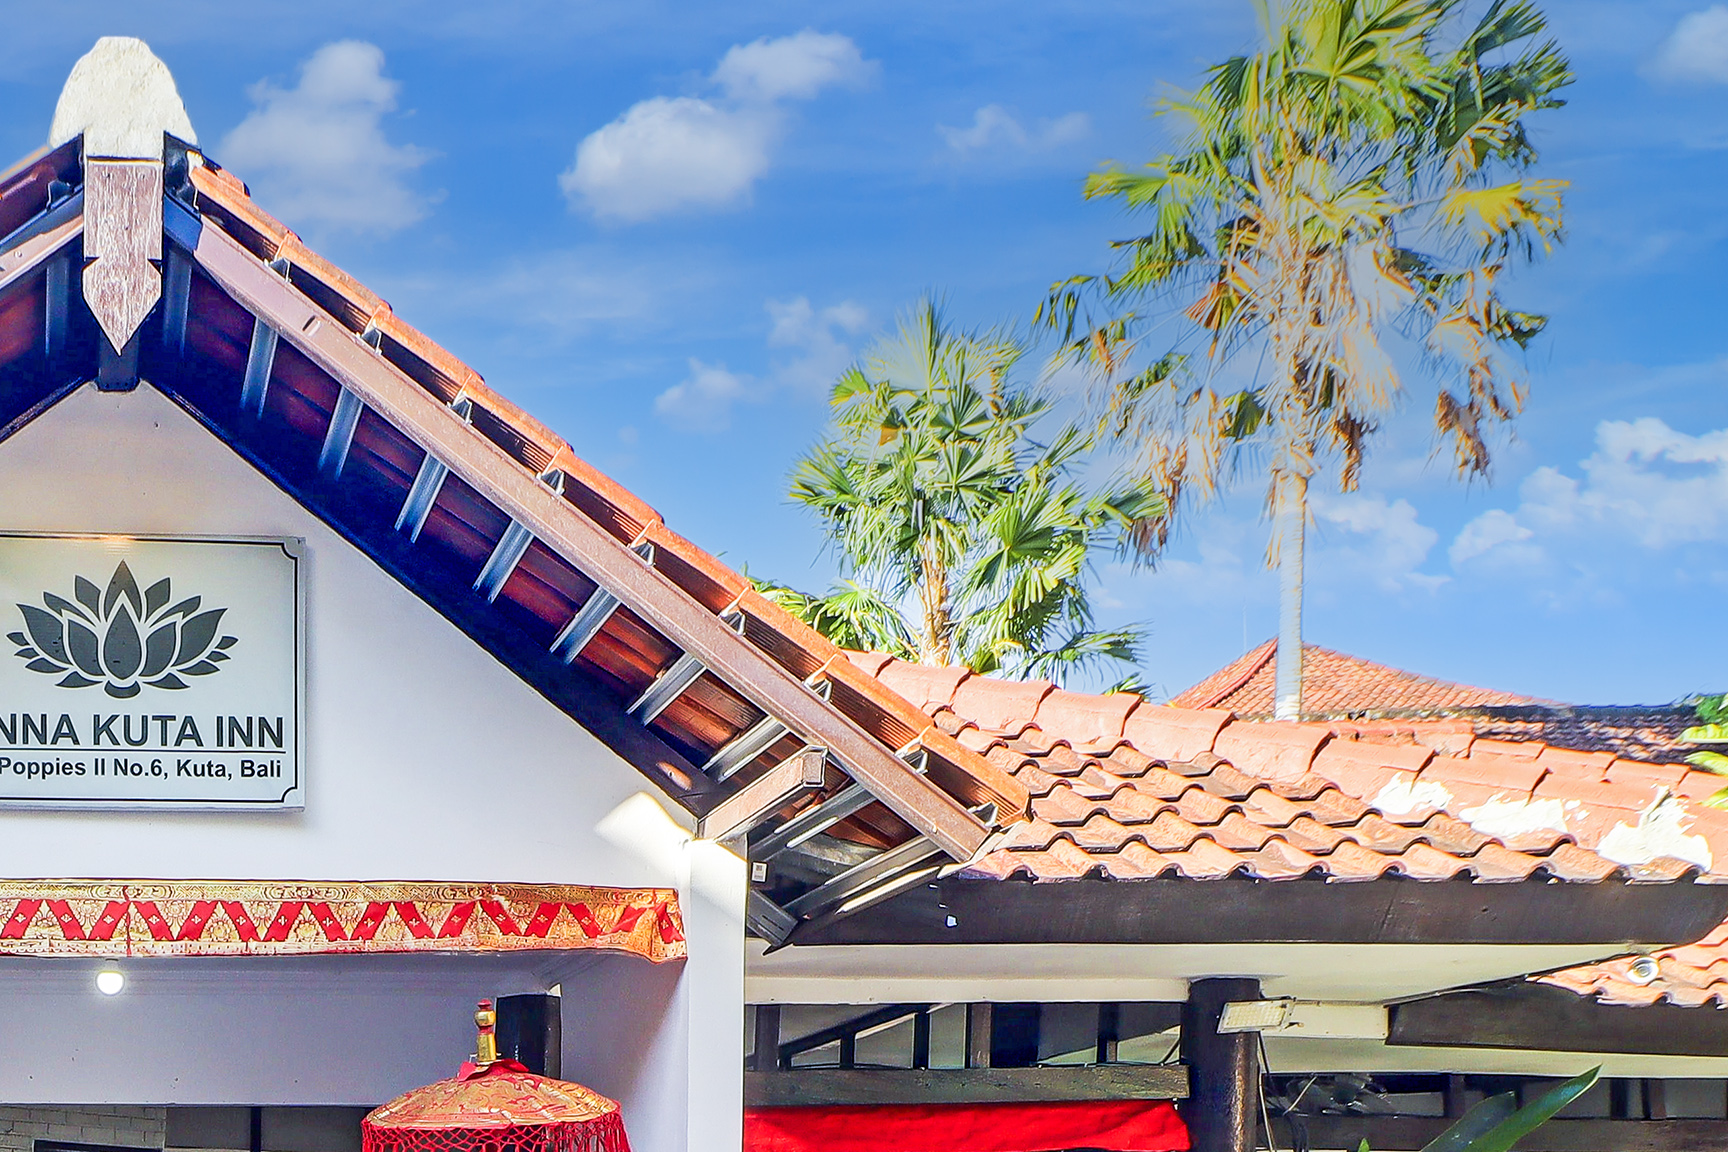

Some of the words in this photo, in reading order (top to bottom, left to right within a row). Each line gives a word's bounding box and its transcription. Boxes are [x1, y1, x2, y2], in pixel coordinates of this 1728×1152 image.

[92, 714, 204, 747] KUTA
[216, 715, 284, 748] INN
[94, 758, 105, 776] II
[113, 758, 169, 780] No.6,
[176, 759, 233, 781] Kuta,
[240, 760, 281, 778] Bali
